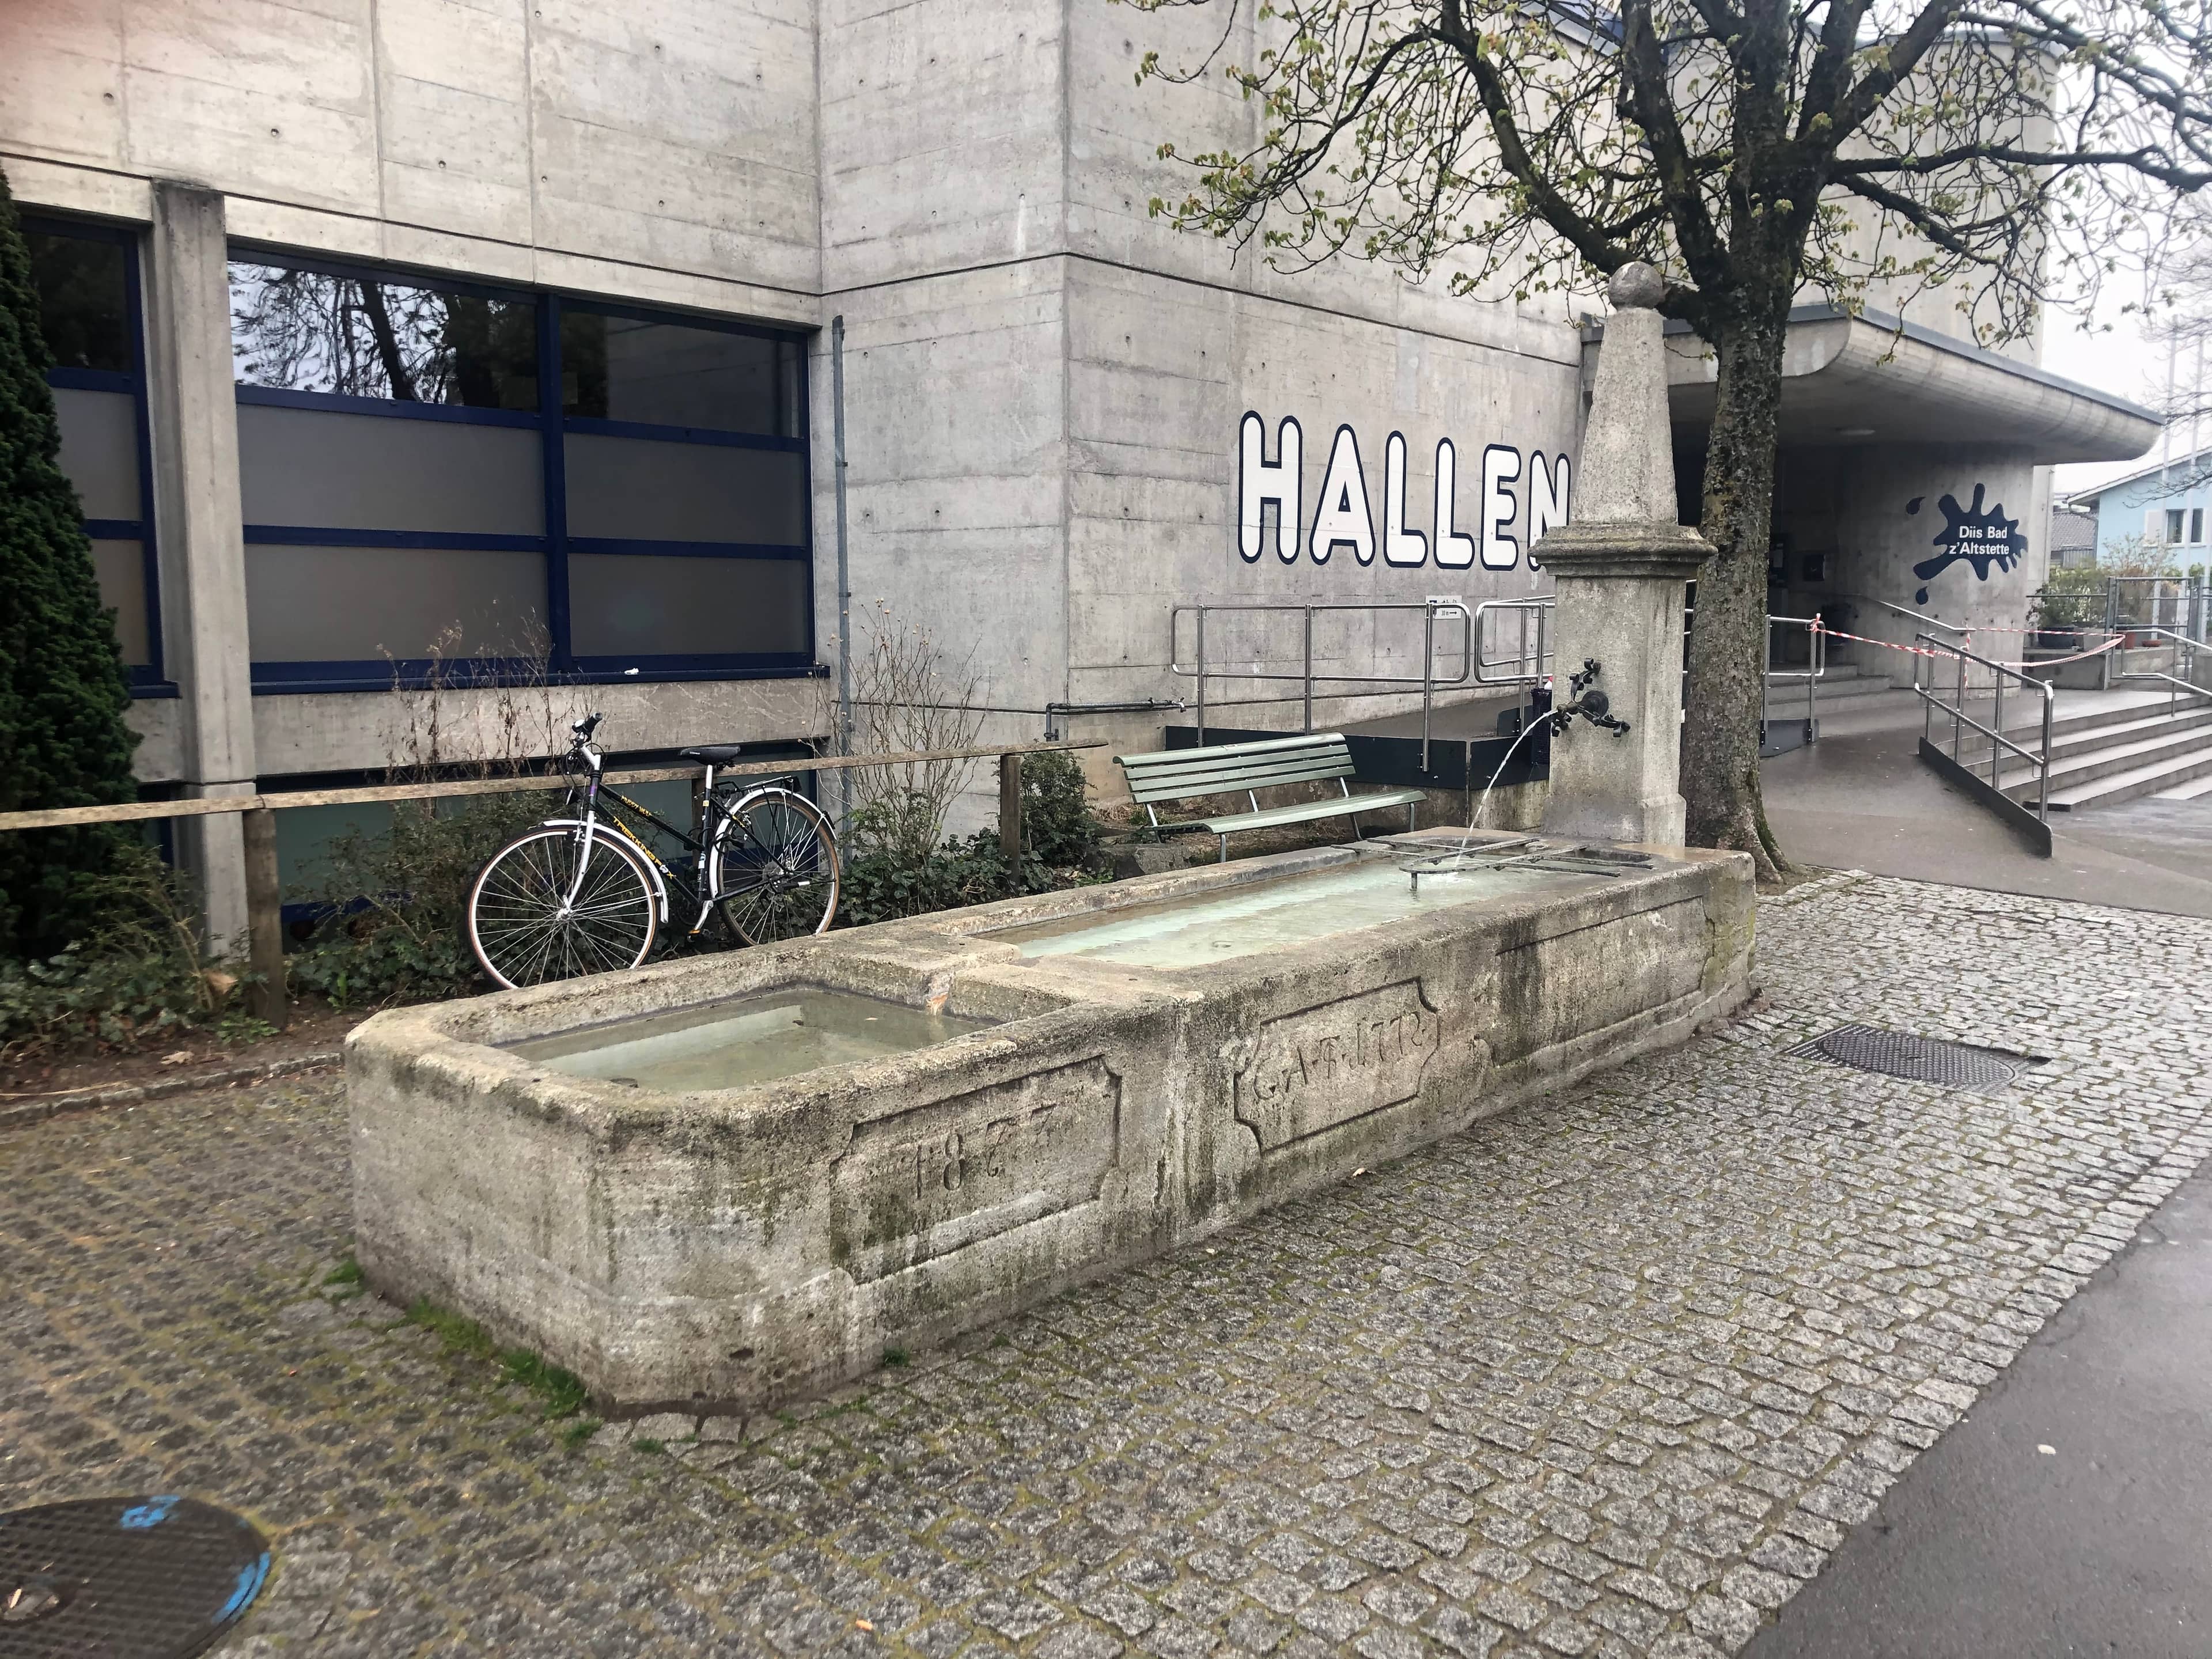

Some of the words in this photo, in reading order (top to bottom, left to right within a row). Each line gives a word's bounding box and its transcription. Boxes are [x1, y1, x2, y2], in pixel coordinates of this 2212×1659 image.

[1238, 410, 1571, 572] HALLEN
[1959, 525, 1983, 539] Diis
[1987, 525, 2008, 539] Bad
[1949, 541, 2010, 555] z'Altstette
